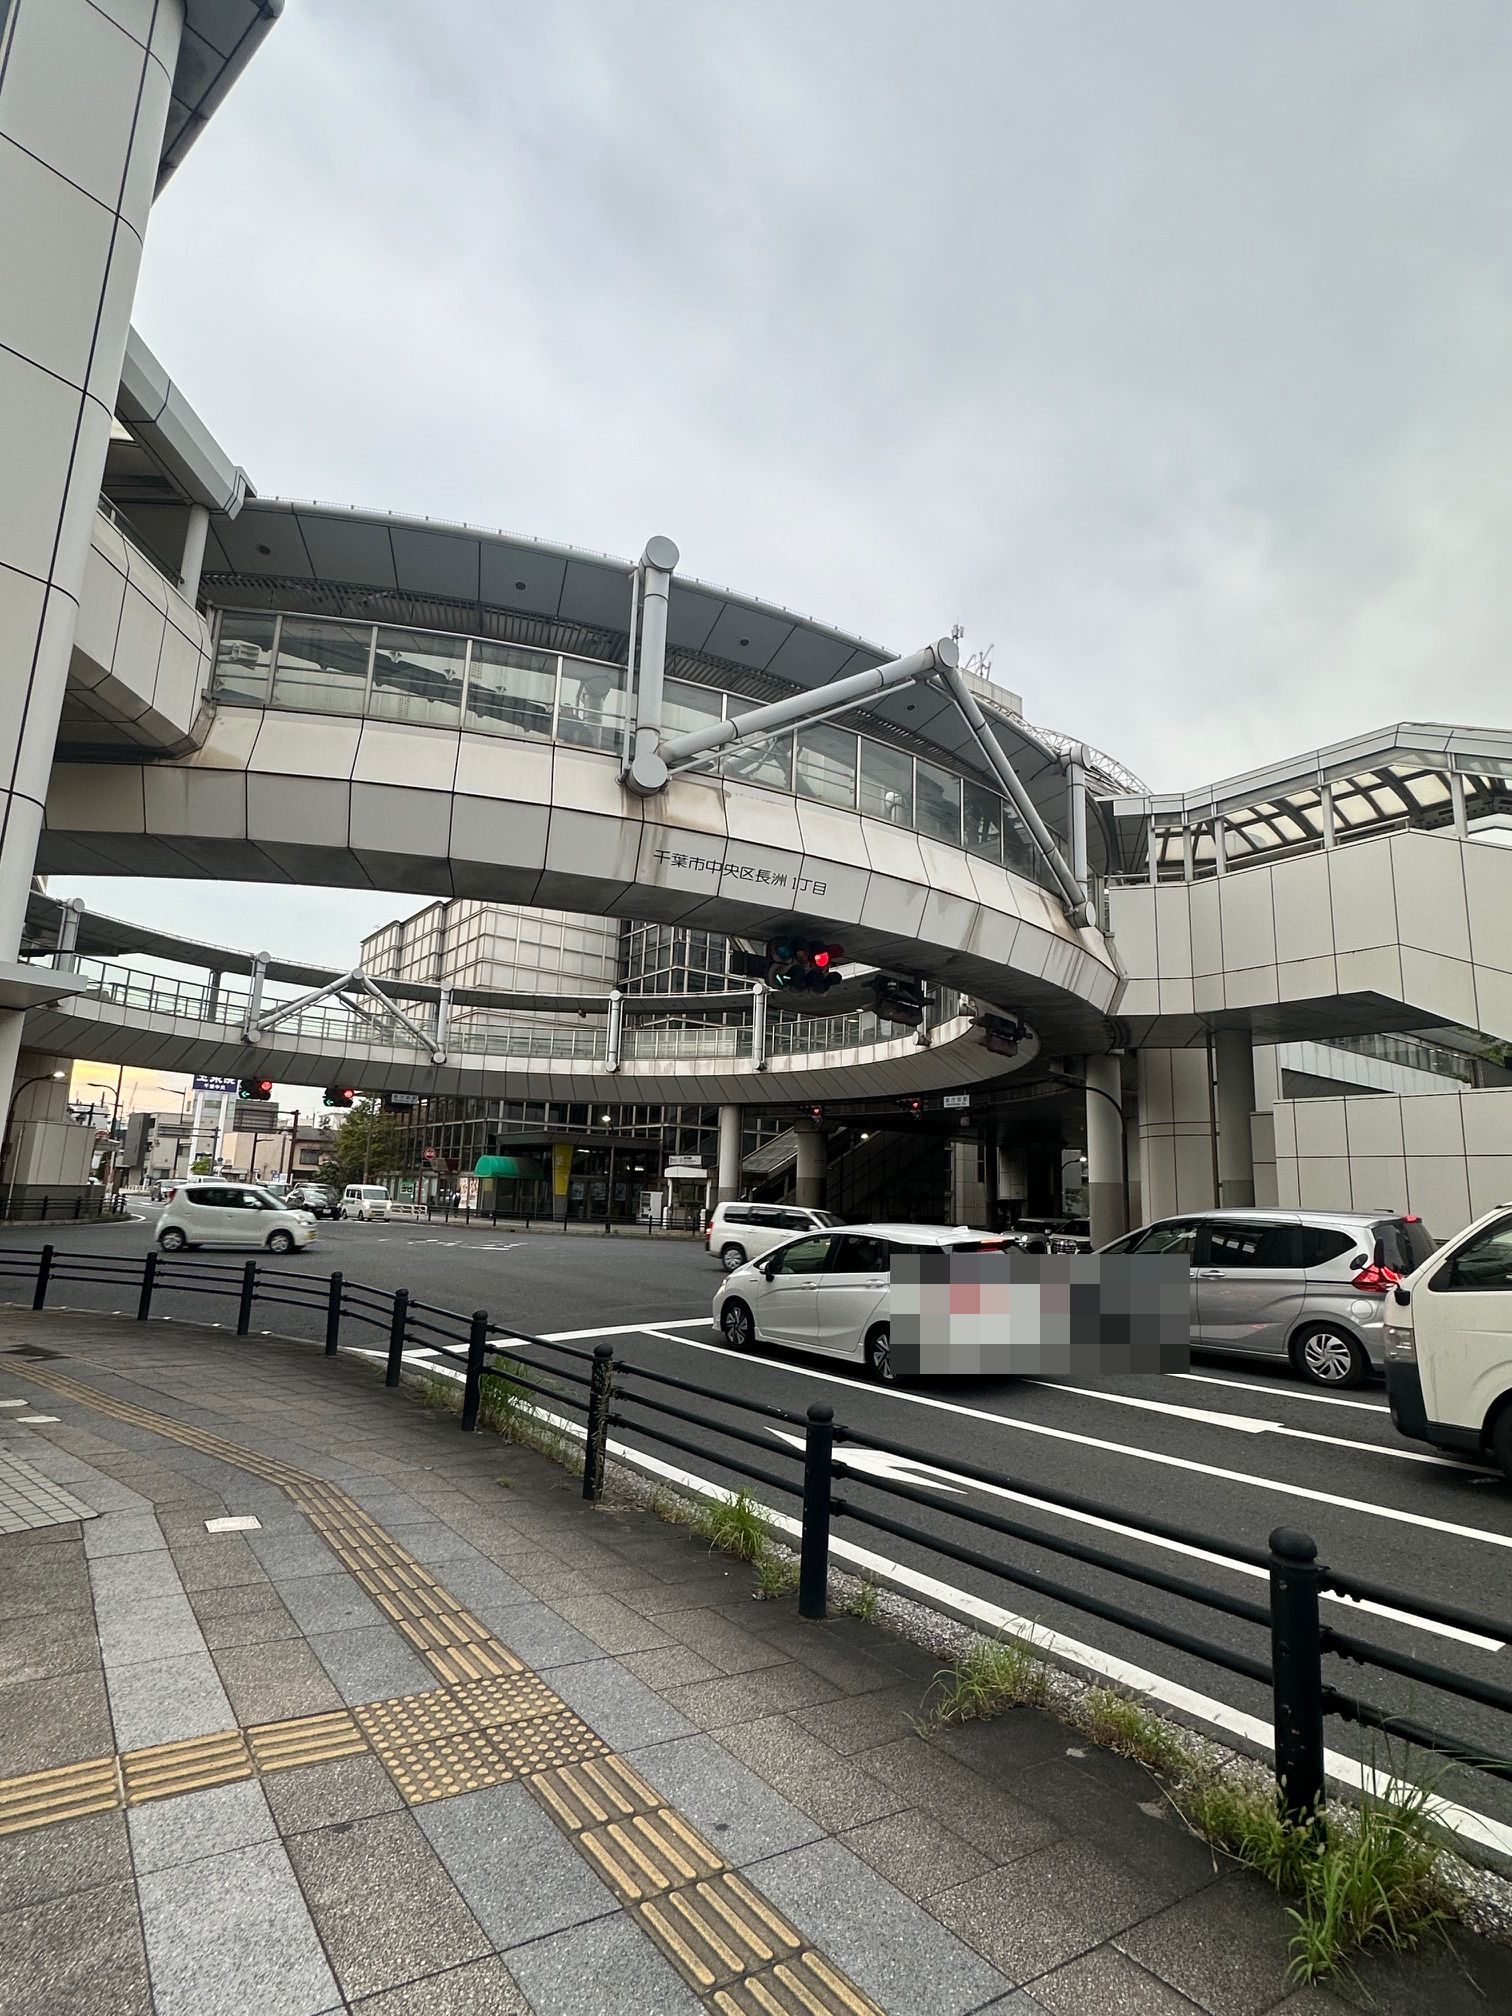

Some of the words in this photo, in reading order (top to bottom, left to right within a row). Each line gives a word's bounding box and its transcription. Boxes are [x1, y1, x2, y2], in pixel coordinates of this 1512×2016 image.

[653, 849, 827, 896] 千葉市中央区長洲1丁目
